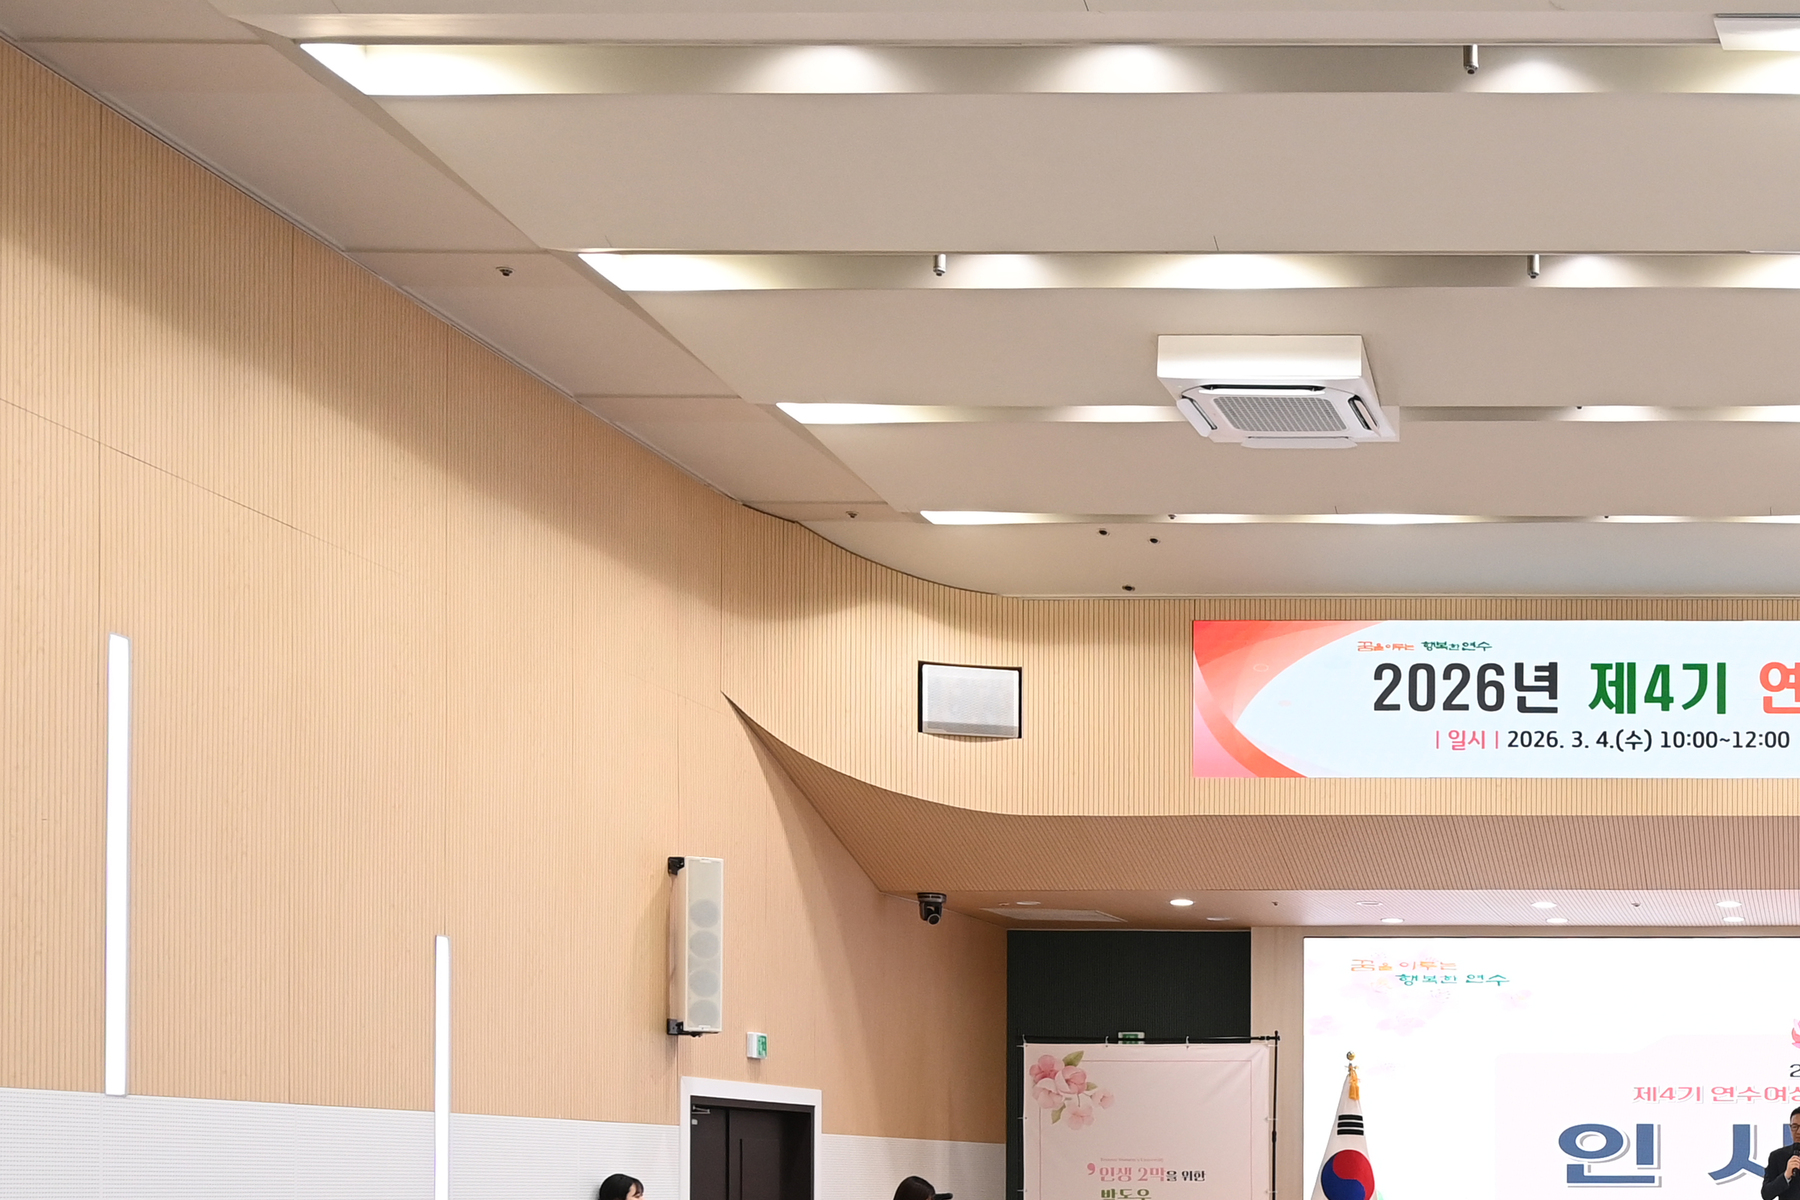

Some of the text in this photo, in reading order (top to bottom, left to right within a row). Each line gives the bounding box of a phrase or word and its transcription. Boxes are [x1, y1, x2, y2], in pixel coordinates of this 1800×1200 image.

[1373, 661, 1559, 714] 2026년
[1587, 661, 1727, 715] 제4기
[1448, 728, 1790, 753] 일시 2026. 3. 4.(수) 10:00~12:00
[1633, 1086, 1702, 1102] 제4기
[1100, 1167, 1132, 1182] 인생
[1181, 1170, 1206, 1181] 위한
